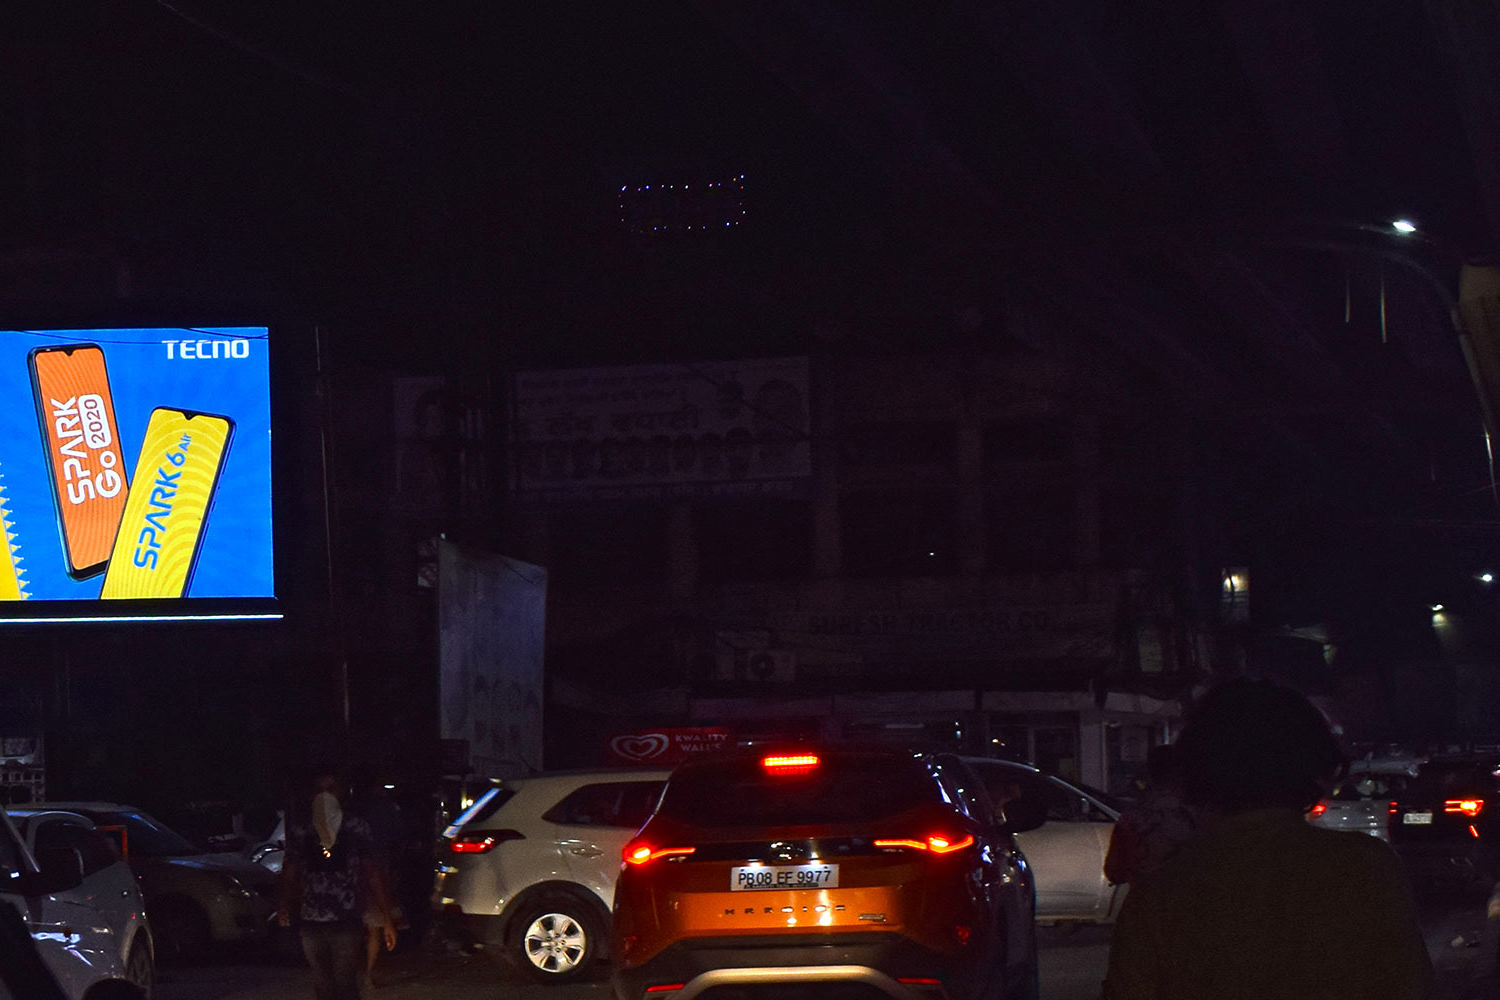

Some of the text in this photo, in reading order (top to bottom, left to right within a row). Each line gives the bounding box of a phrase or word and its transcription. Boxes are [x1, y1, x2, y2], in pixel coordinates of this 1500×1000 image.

[161, 339, 249, 360] TECNO
[83, 398, 105, 444] 2020
[50, 395, 96, 505] SPARK
[95, 450, 122, 498] Go
[133, 432, 193, 571] SPARK 6 Air
[674, 733, 728, 742] KWALITY
[797, 870, 831, 884] 9977
